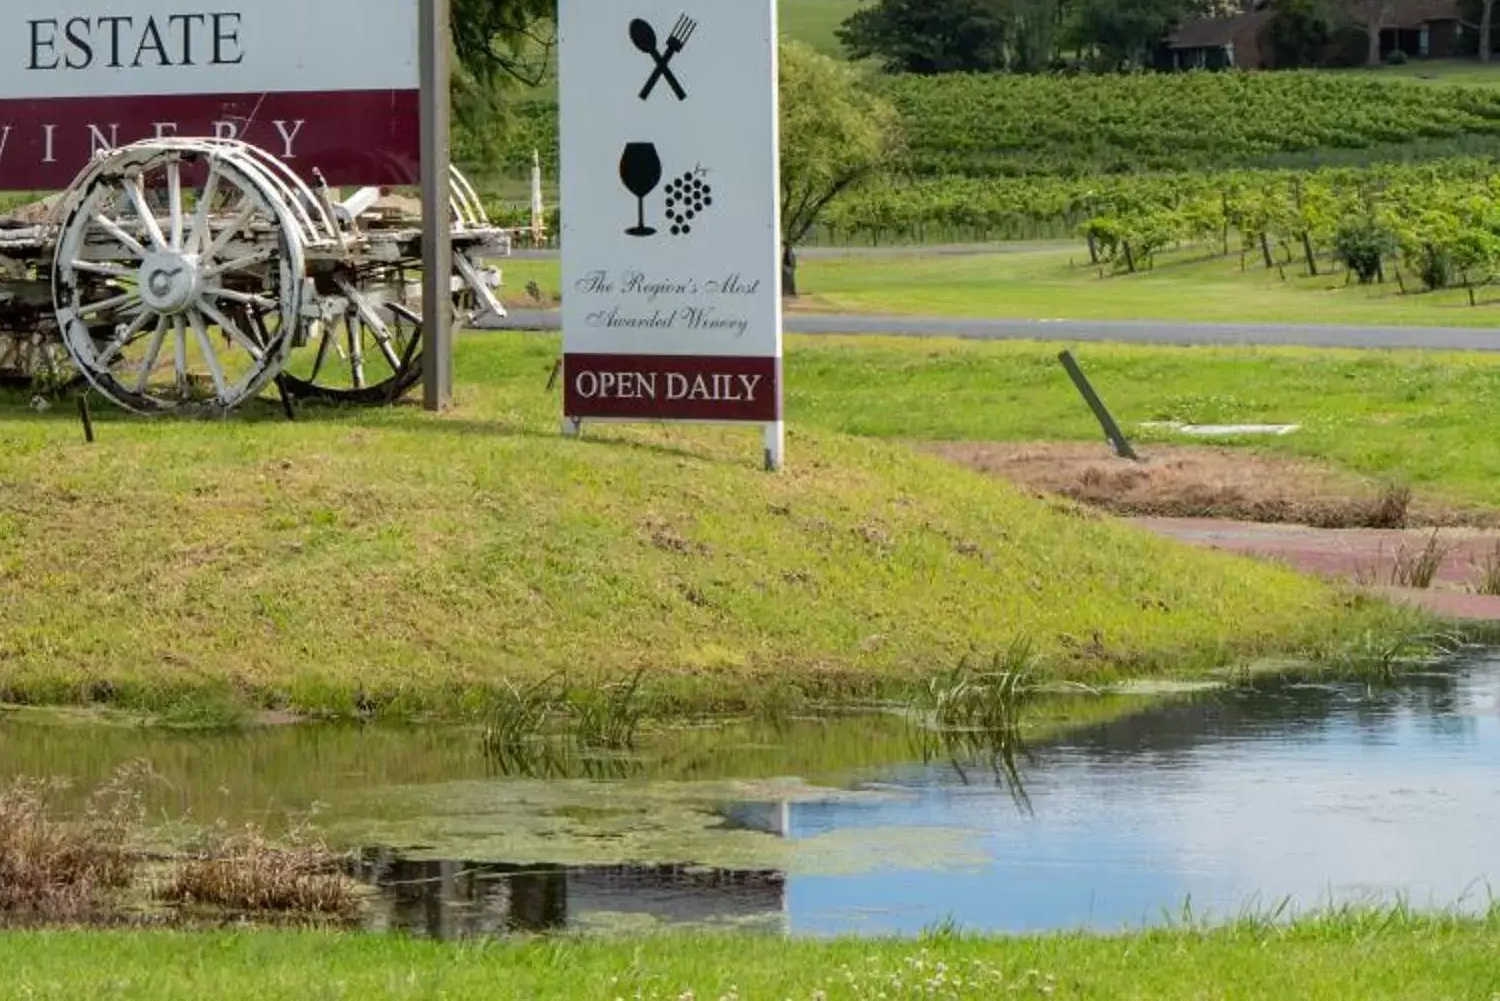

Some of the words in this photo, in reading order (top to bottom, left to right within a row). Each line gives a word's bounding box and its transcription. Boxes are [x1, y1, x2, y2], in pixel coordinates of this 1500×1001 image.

[25, 12, 245, 71] ESTATE
[575, 270, 613, 295] The
[620, 271, 697, 301] Region's
[705, 271, 760, 294] Most
[585, 309, 676, 329] Awarded
[680, 306, 749, 337] Winery
[575, 370, 658, 400] OPEN
[664, 372, 764, 401] DAILY
